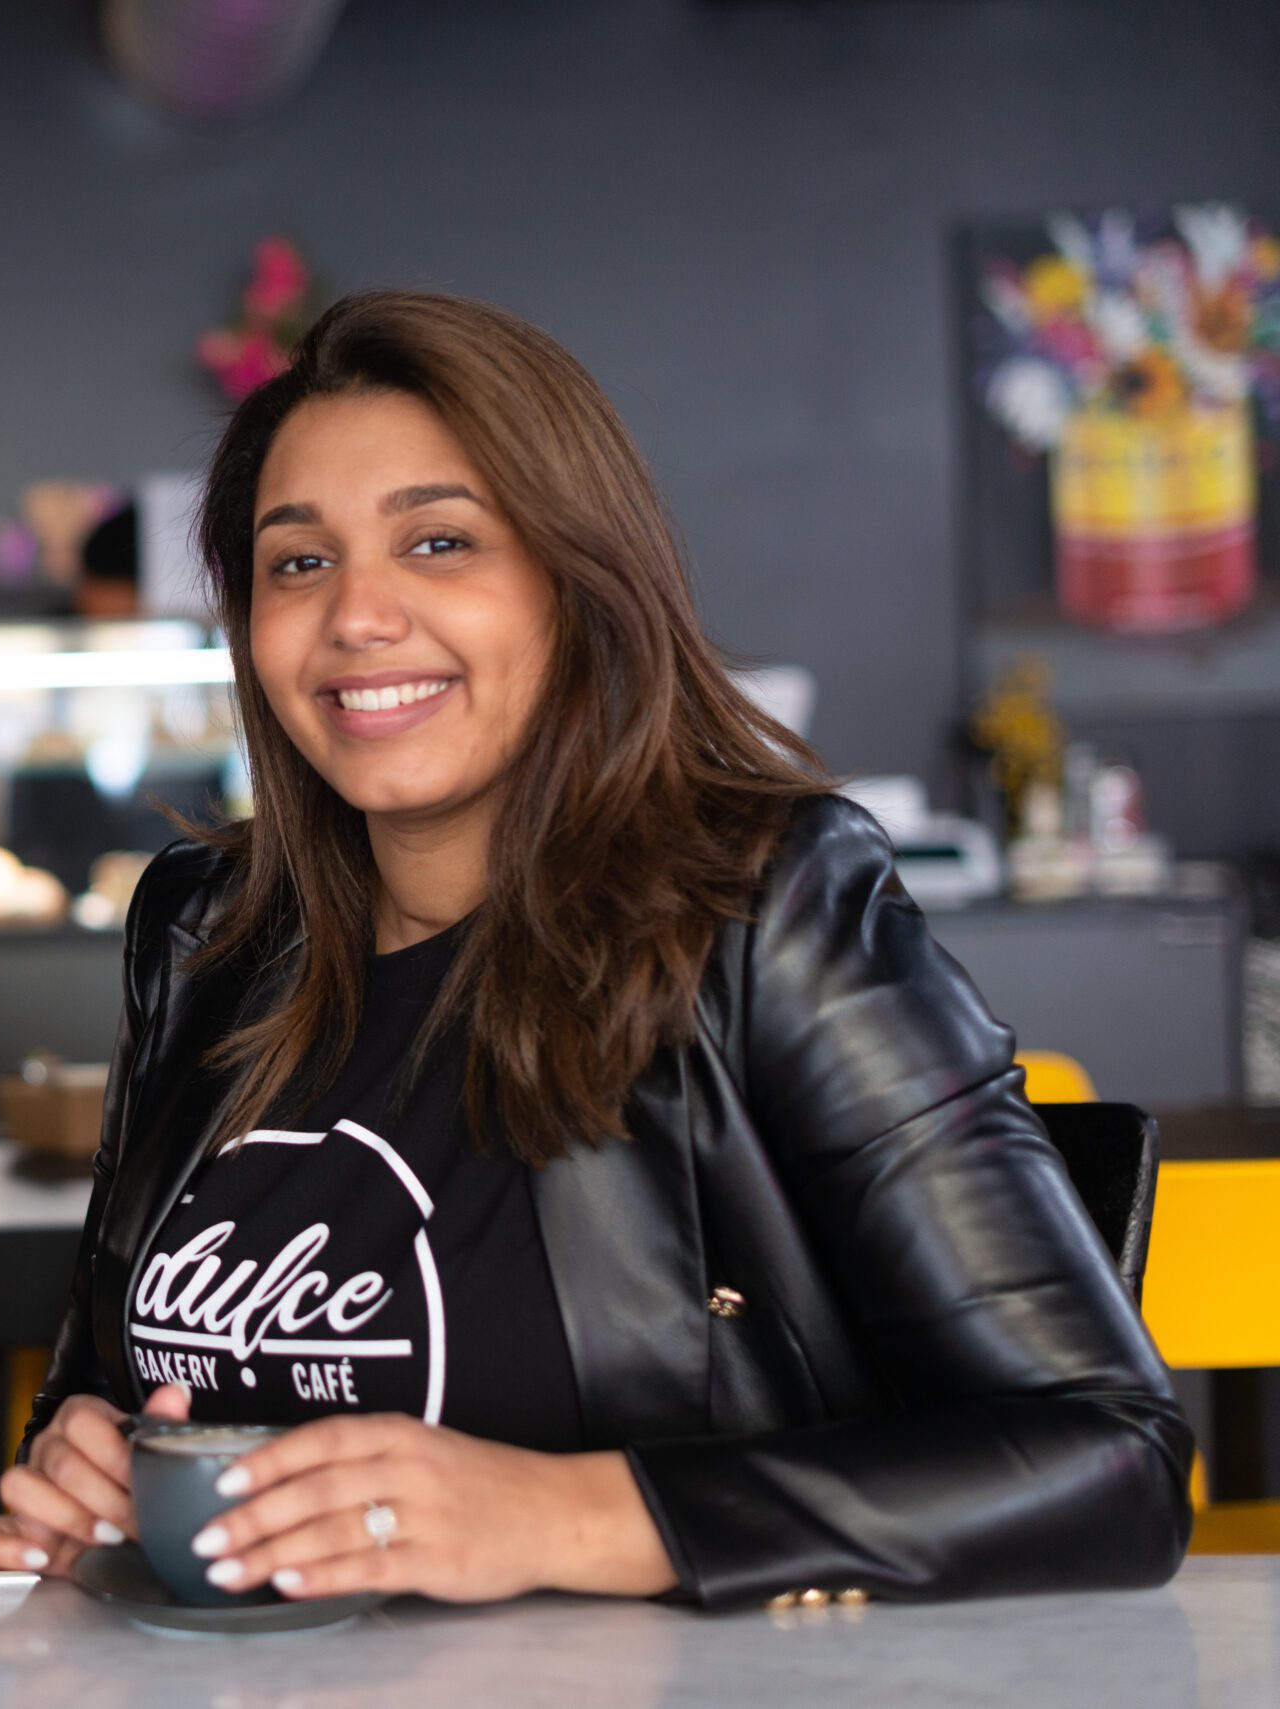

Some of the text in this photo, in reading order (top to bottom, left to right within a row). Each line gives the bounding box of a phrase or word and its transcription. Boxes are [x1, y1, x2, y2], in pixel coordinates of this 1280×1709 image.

[134, 1220, 394, 1361] dulce
[133, 1345, 360, 1403] BAKERY CAFÉ
